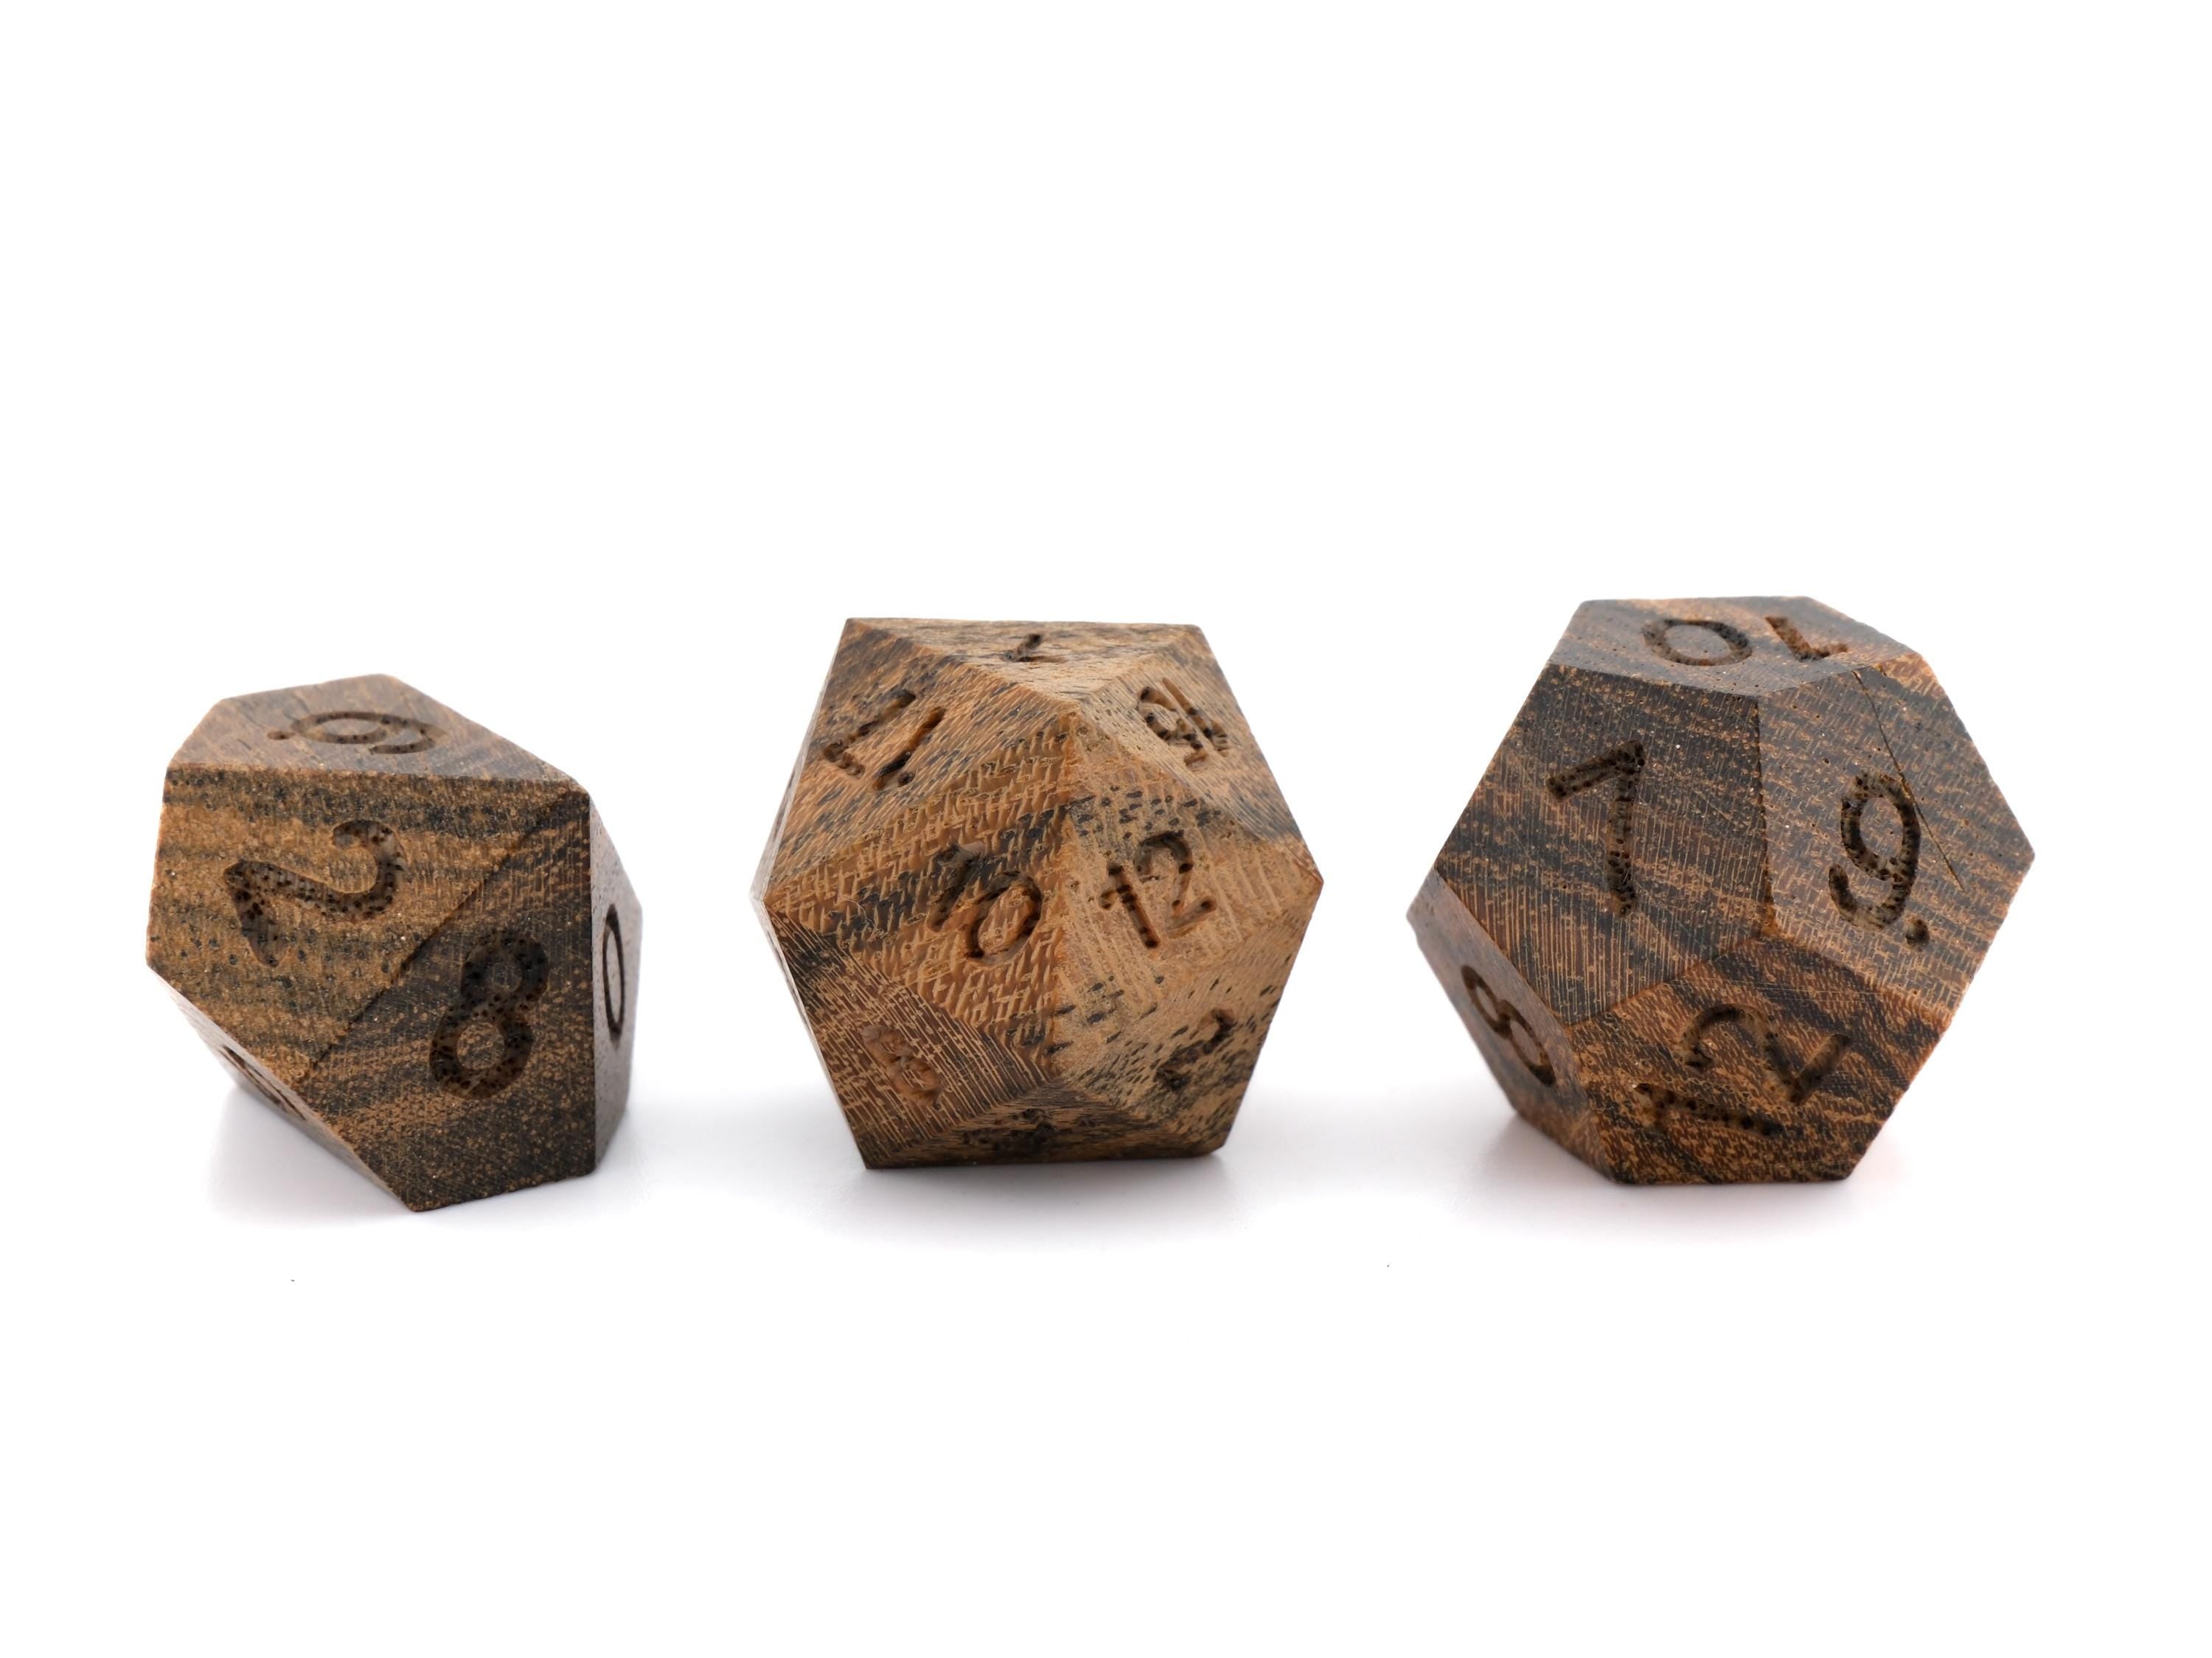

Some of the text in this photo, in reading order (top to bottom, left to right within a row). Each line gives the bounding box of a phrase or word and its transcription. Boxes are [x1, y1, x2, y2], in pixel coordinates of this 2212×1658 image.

[221, 818, 409, 967] 2
[925, 842, 1043, 964] 10
[1099, 829, 1219, 951] 12
[429, 929, 549, 1098] 8
[1460, 964, 1557, 1088] 8
[1631, 1003, 1851, 1139] 12
